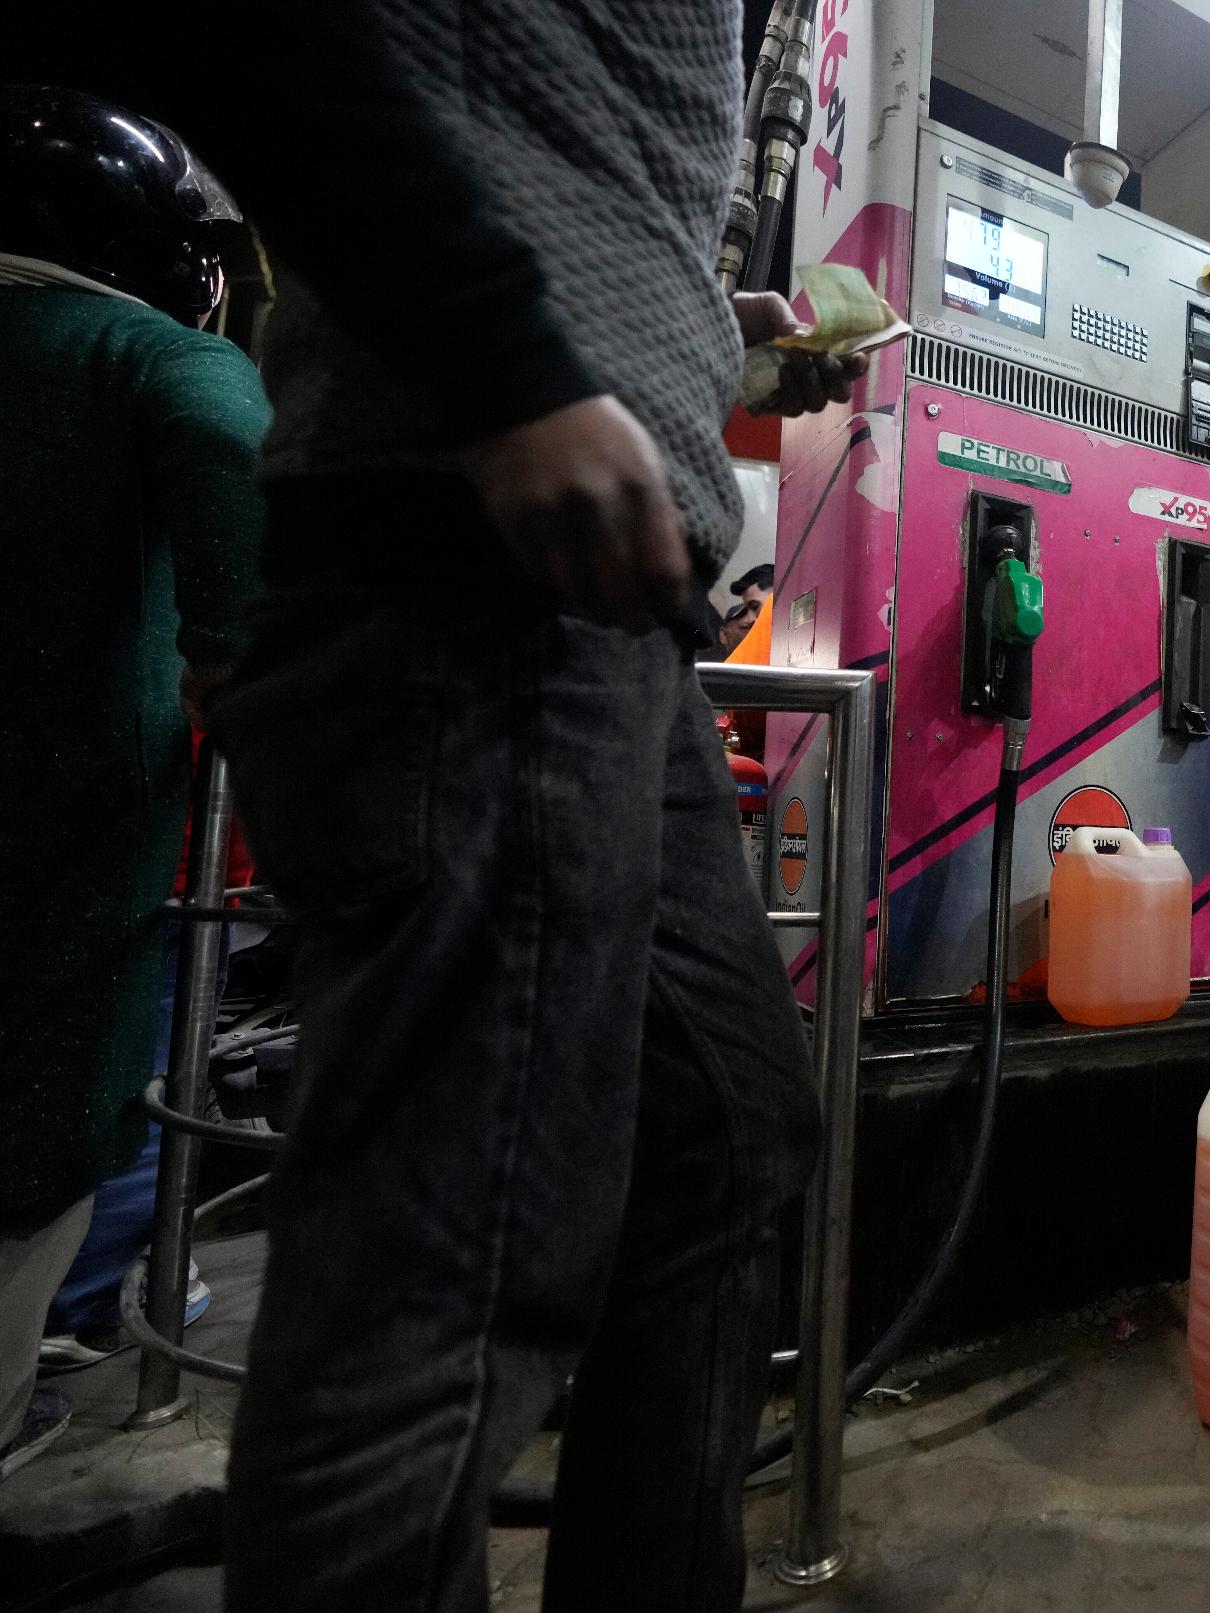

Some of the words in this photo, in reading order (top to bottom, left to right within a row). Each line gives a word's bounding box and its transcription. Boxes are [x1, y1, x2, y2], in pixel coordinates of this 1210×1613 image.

[975, 271, 1004, 288] Volume
[960, 437, 1053, 478] PETROL
[1159, 496, 1209, 525] XP95
